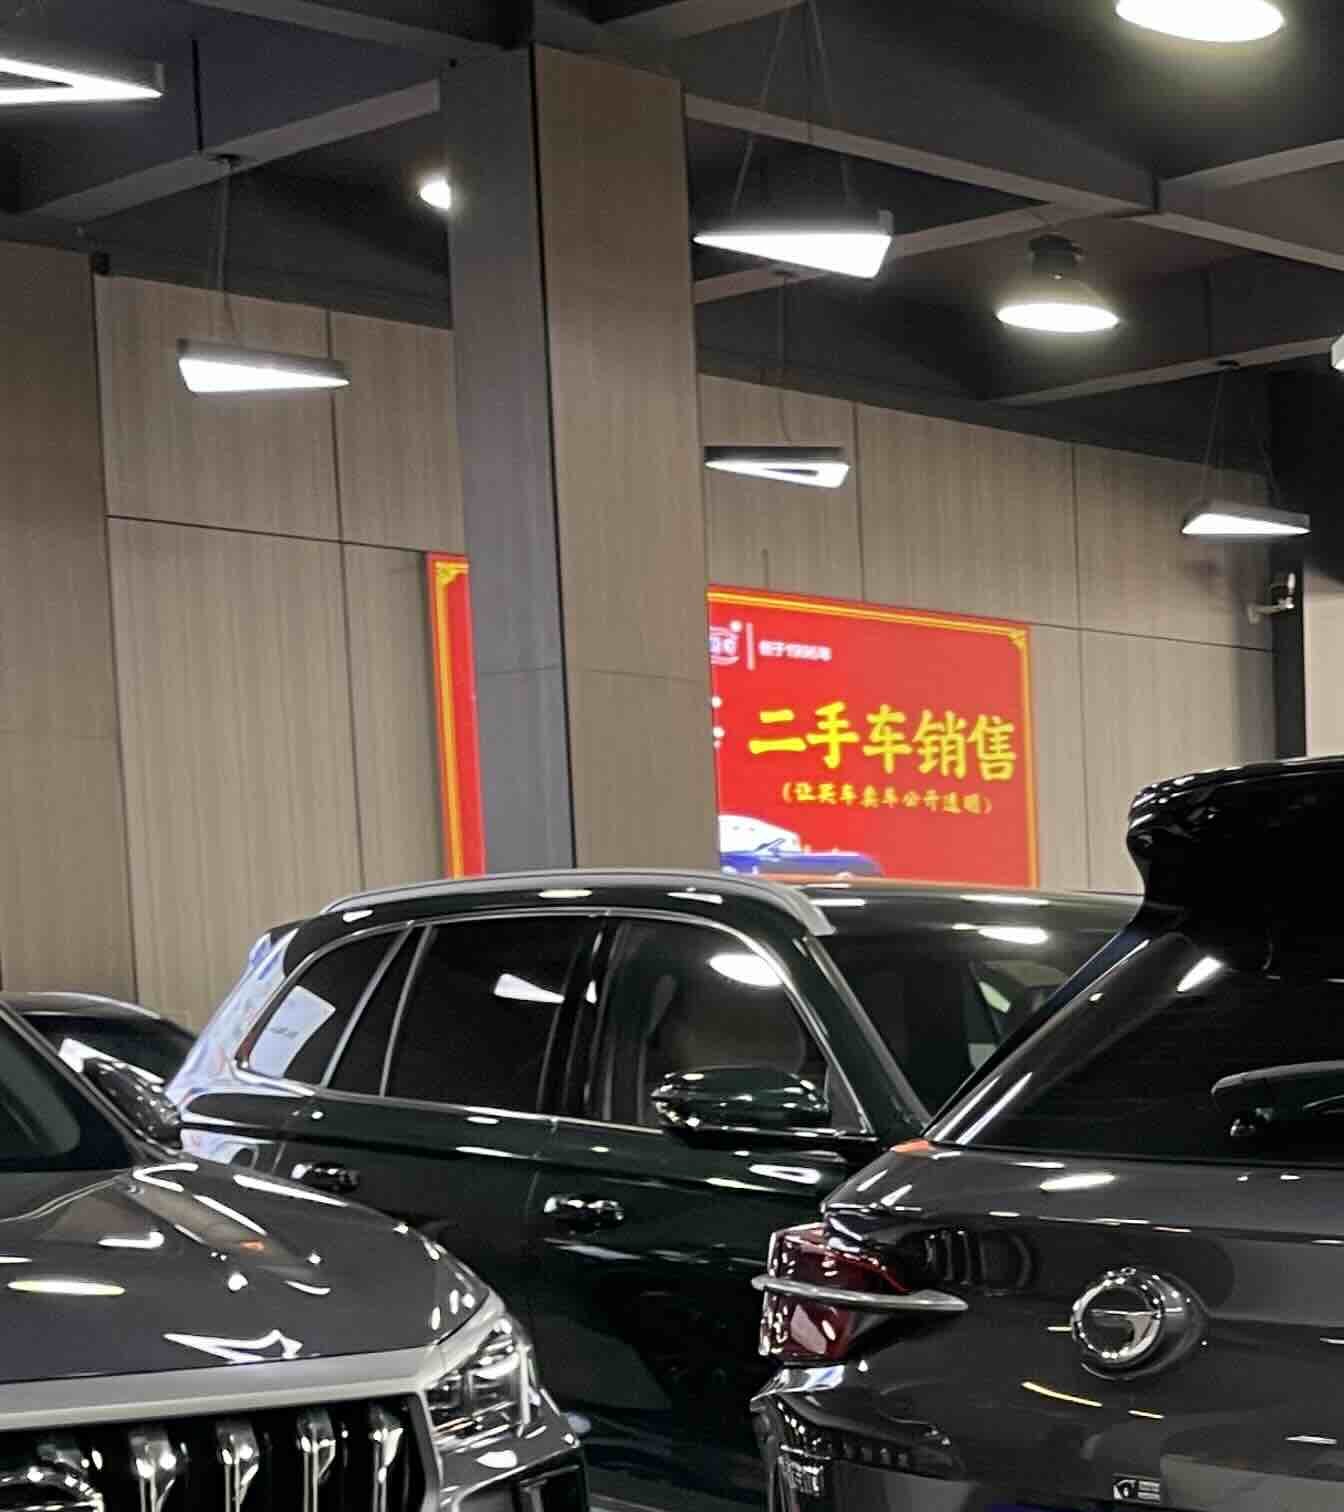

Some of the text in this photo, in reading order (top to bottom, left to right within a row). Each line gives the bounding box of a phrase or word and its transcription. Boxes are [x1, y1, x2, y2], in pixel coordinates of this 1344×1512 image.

[749, 701, 1017, 781] 二手车销售
